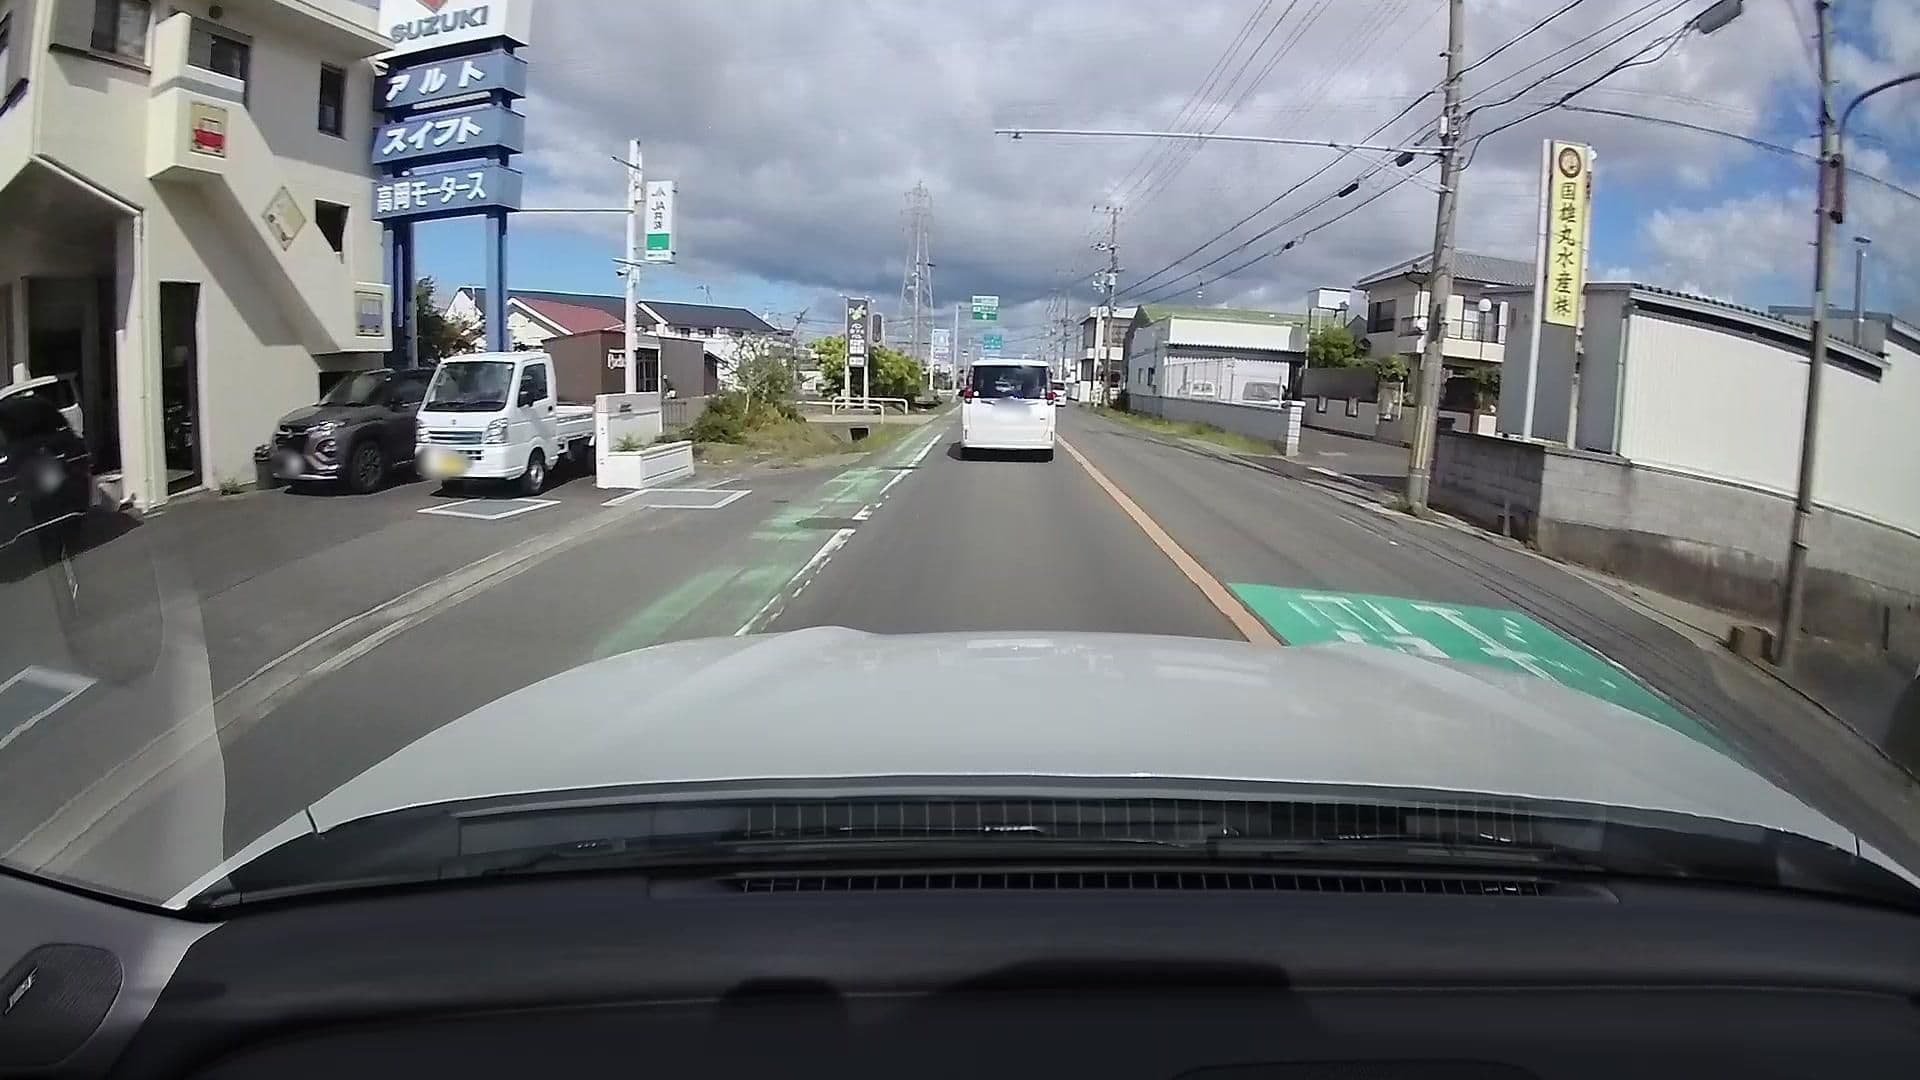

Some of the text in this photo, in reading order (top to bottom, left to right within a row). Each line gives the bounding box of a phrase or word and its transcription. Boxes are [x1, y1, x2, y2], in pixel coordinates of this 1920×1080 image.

[390, 5, 489, 44] SUZUKI
[385, 60, 486, 101] アルト
[382, 116, 483, 155] スイフト
[376, 171, 487, 213] 高岡モータース
